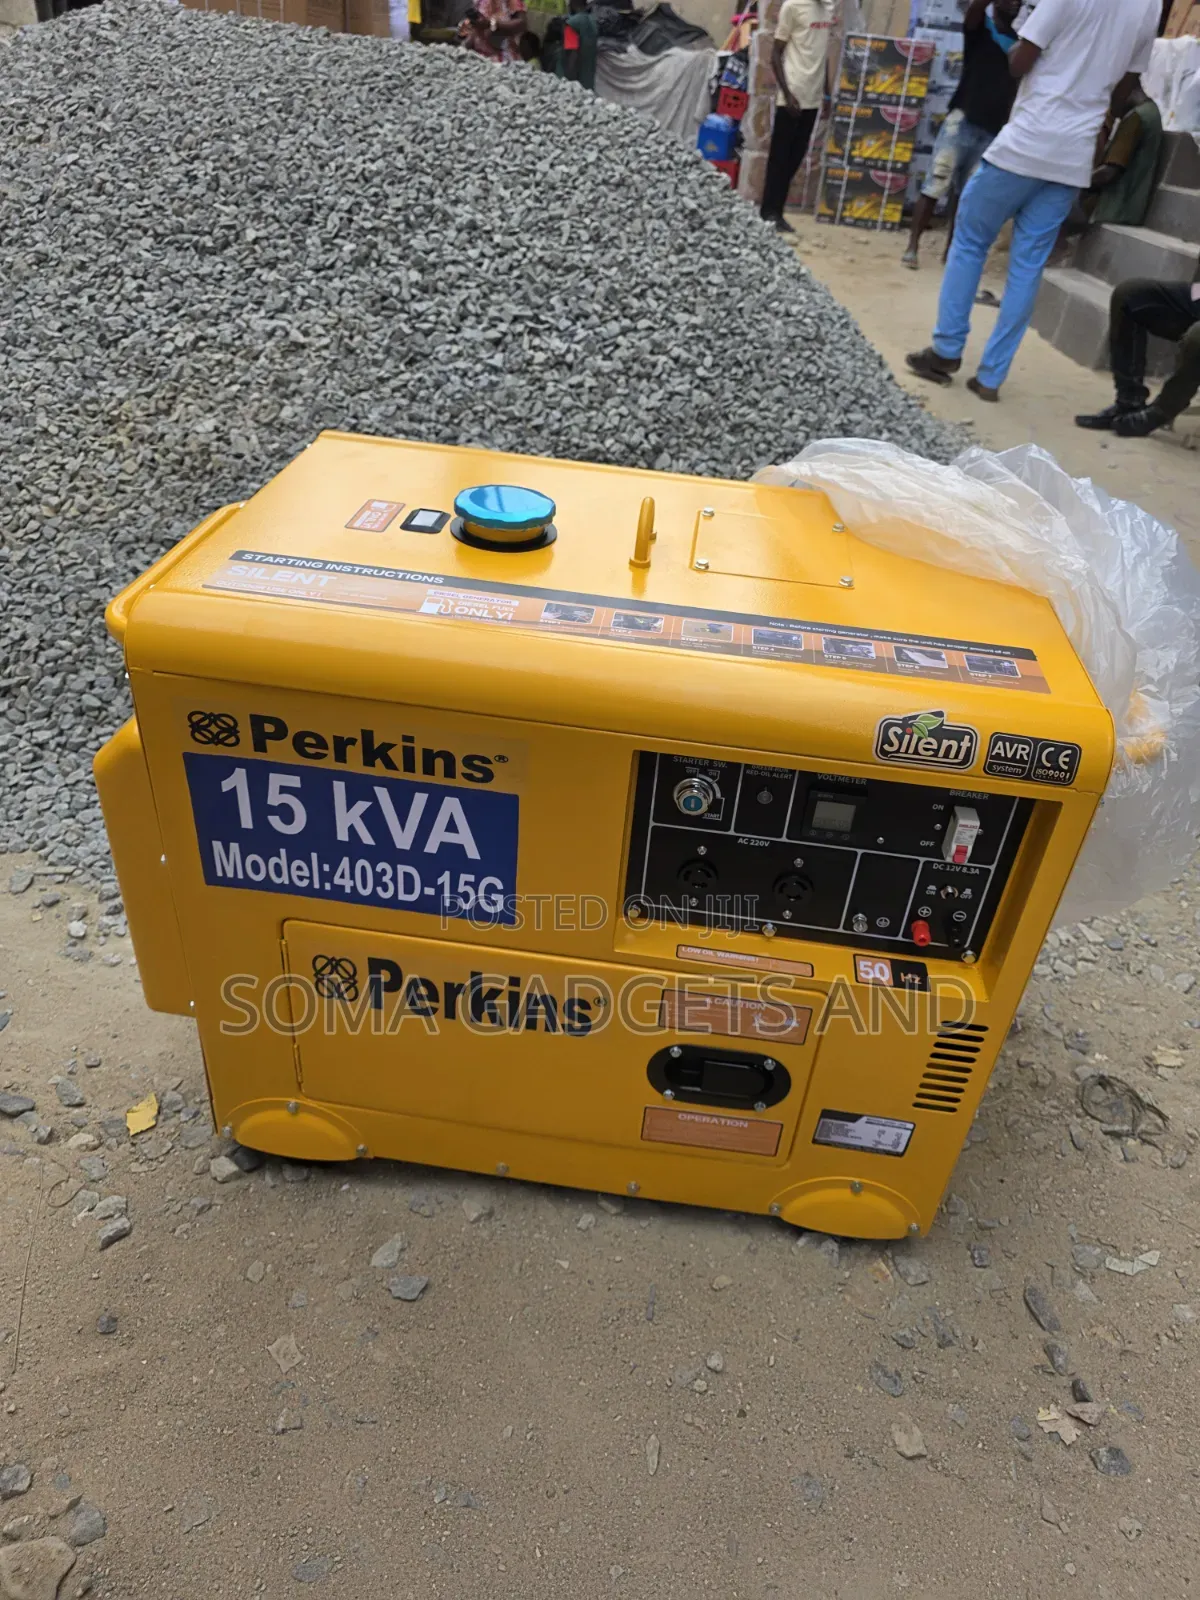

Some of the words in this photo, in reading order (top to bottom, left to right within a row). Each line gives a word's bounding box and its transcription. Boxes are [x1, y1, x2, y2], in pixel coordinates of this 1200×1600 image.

[242, 552, 323, 569] STARTING
[325, 563, 445, 584] INSTRUCTIONS
[226, 564, 338, 587] SILENT
[454, 606, 514, 621] ONLY!
[457, 600, 489, 609] DIESEL
[491, 605, 516, 613] FUEL
[882, 726, 972, 763] Silent
[991, 740, 1030, 761] AVR
[672, 755, 710, 767] STARTER
[712, 759, 728, 769] SW.
[992, 763, 1022, 775] system
[745, 768, 771, 778] RED-OIL
[772, 772, 793, 781] ALERT
[817, 773, 868, 786] VOLTMETER
[949, 789, 990, 801] BREAKER
[221, 766, 308, 836] 15
[332, 779, 482, 861] kVA
[932, 803, 945, 811] ON
[737, 837, 749, 845] AC
[749, 837, 771, 848] 220V
[919, 839, 935, 848] OFF
[932, 862, 945, 870] DC
[945, 864, 962, 872] 12V
[212, 840, 505, 914] Model:403D-15G
[682, 946, 702, 955] LOW
[702, 949, 715, 957] OIL
[859, 959, 890, 982] 50
[713, 997, 766, 1011] CAUTION
[677, 1112, 749, 1129] OPERATION
